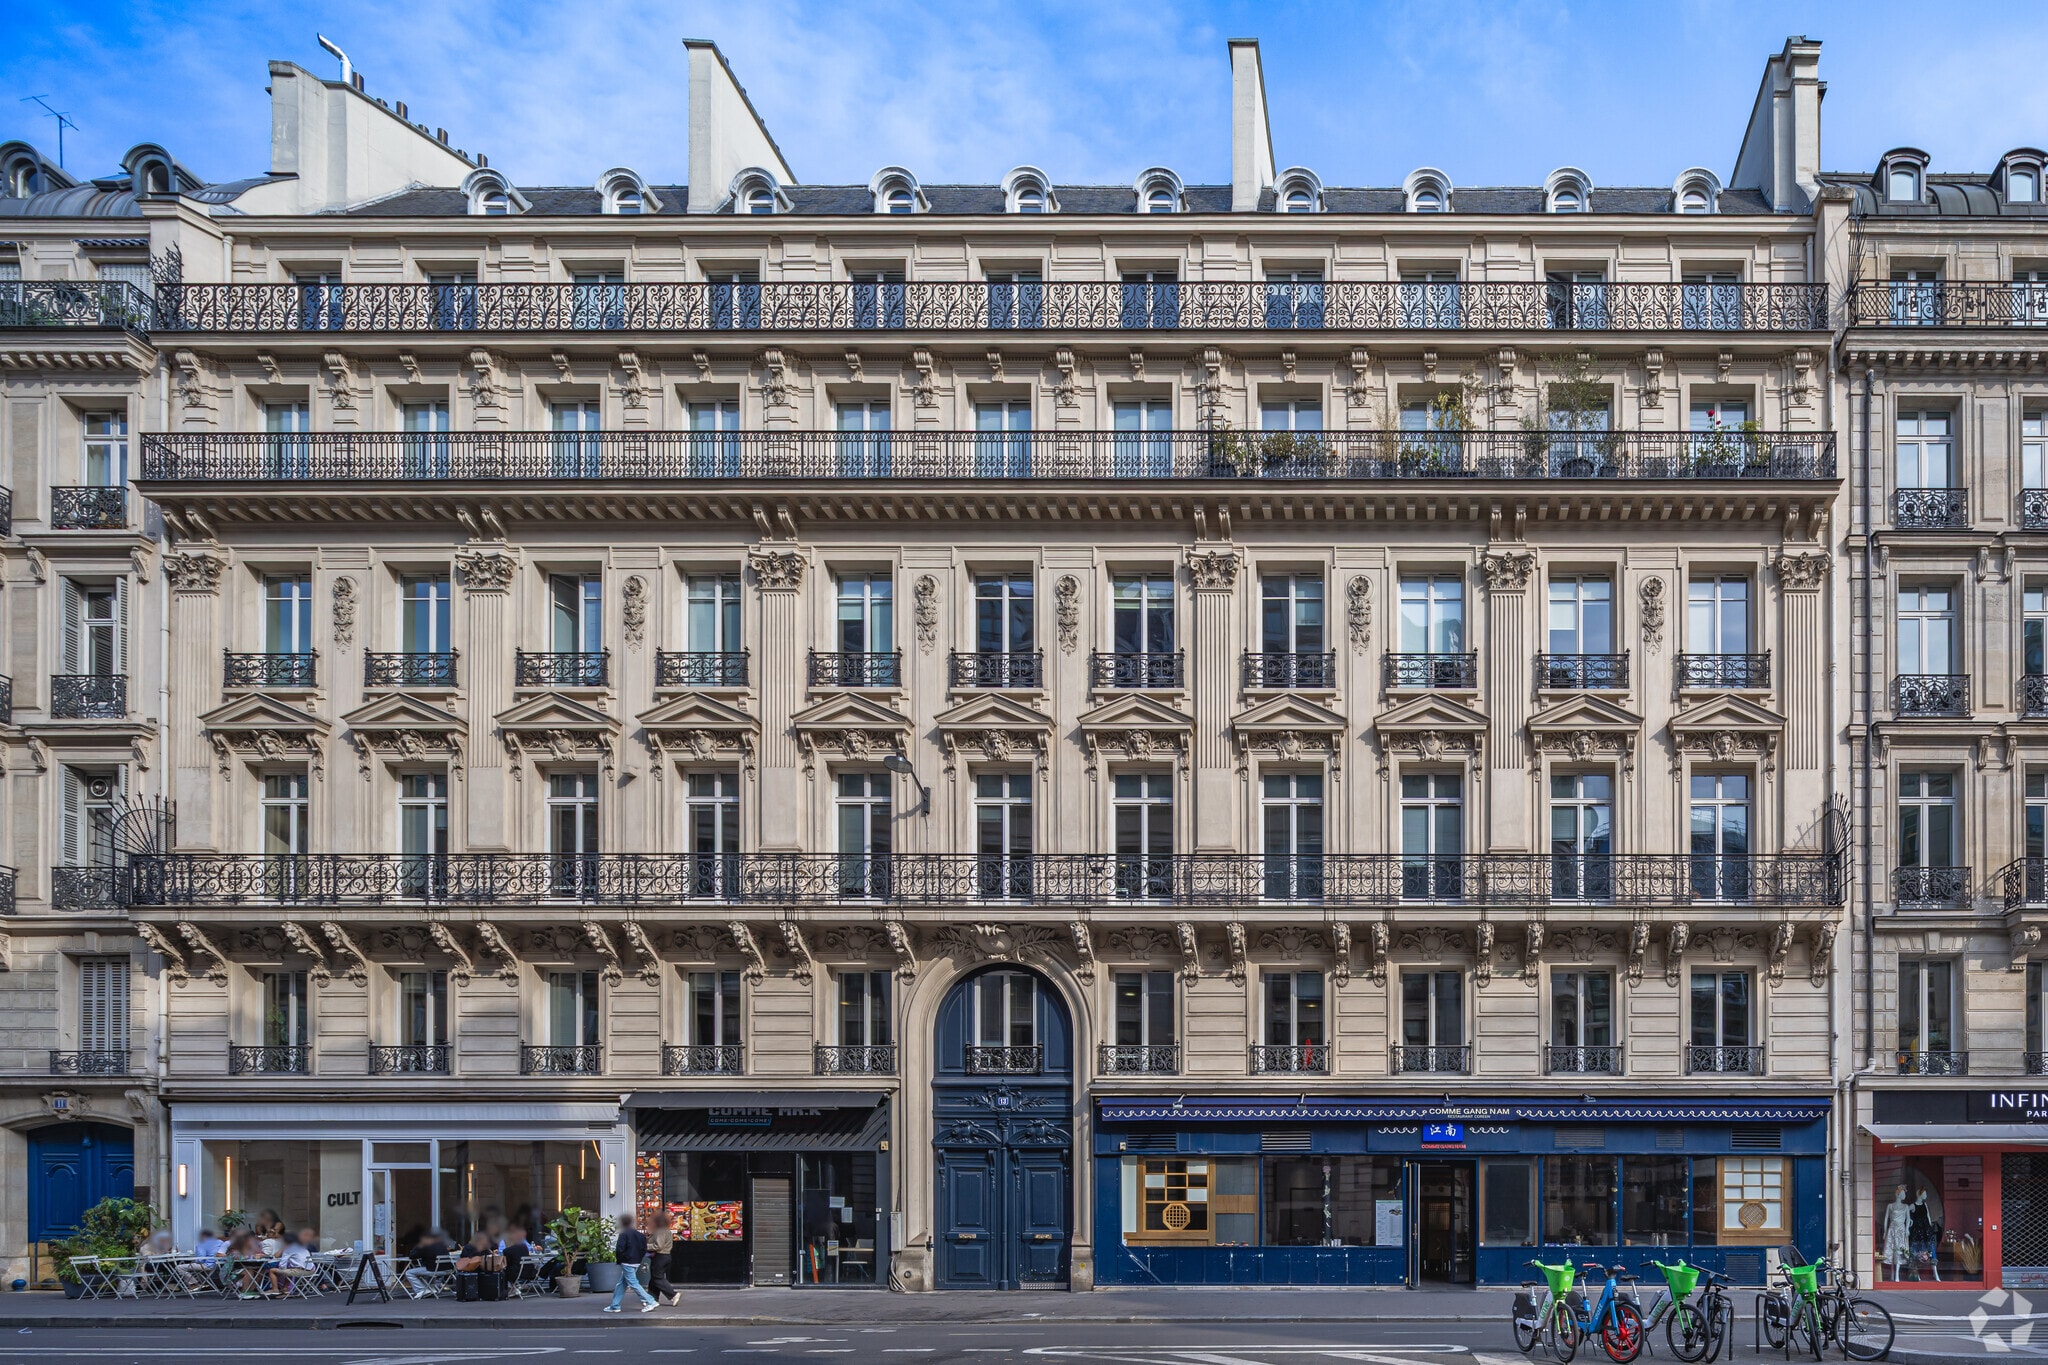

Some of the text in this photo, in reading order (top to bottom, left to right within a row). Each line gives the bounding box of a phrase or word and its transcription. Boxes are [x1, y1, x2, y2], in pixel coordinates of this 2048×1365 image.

[708, 1106, 773, 1116] COMME
[2026, 1110, 2048, 1118] PAR
[1430, 1122, 1457, 1137] 江南
[327, 1191, 361, 1207] CULT
